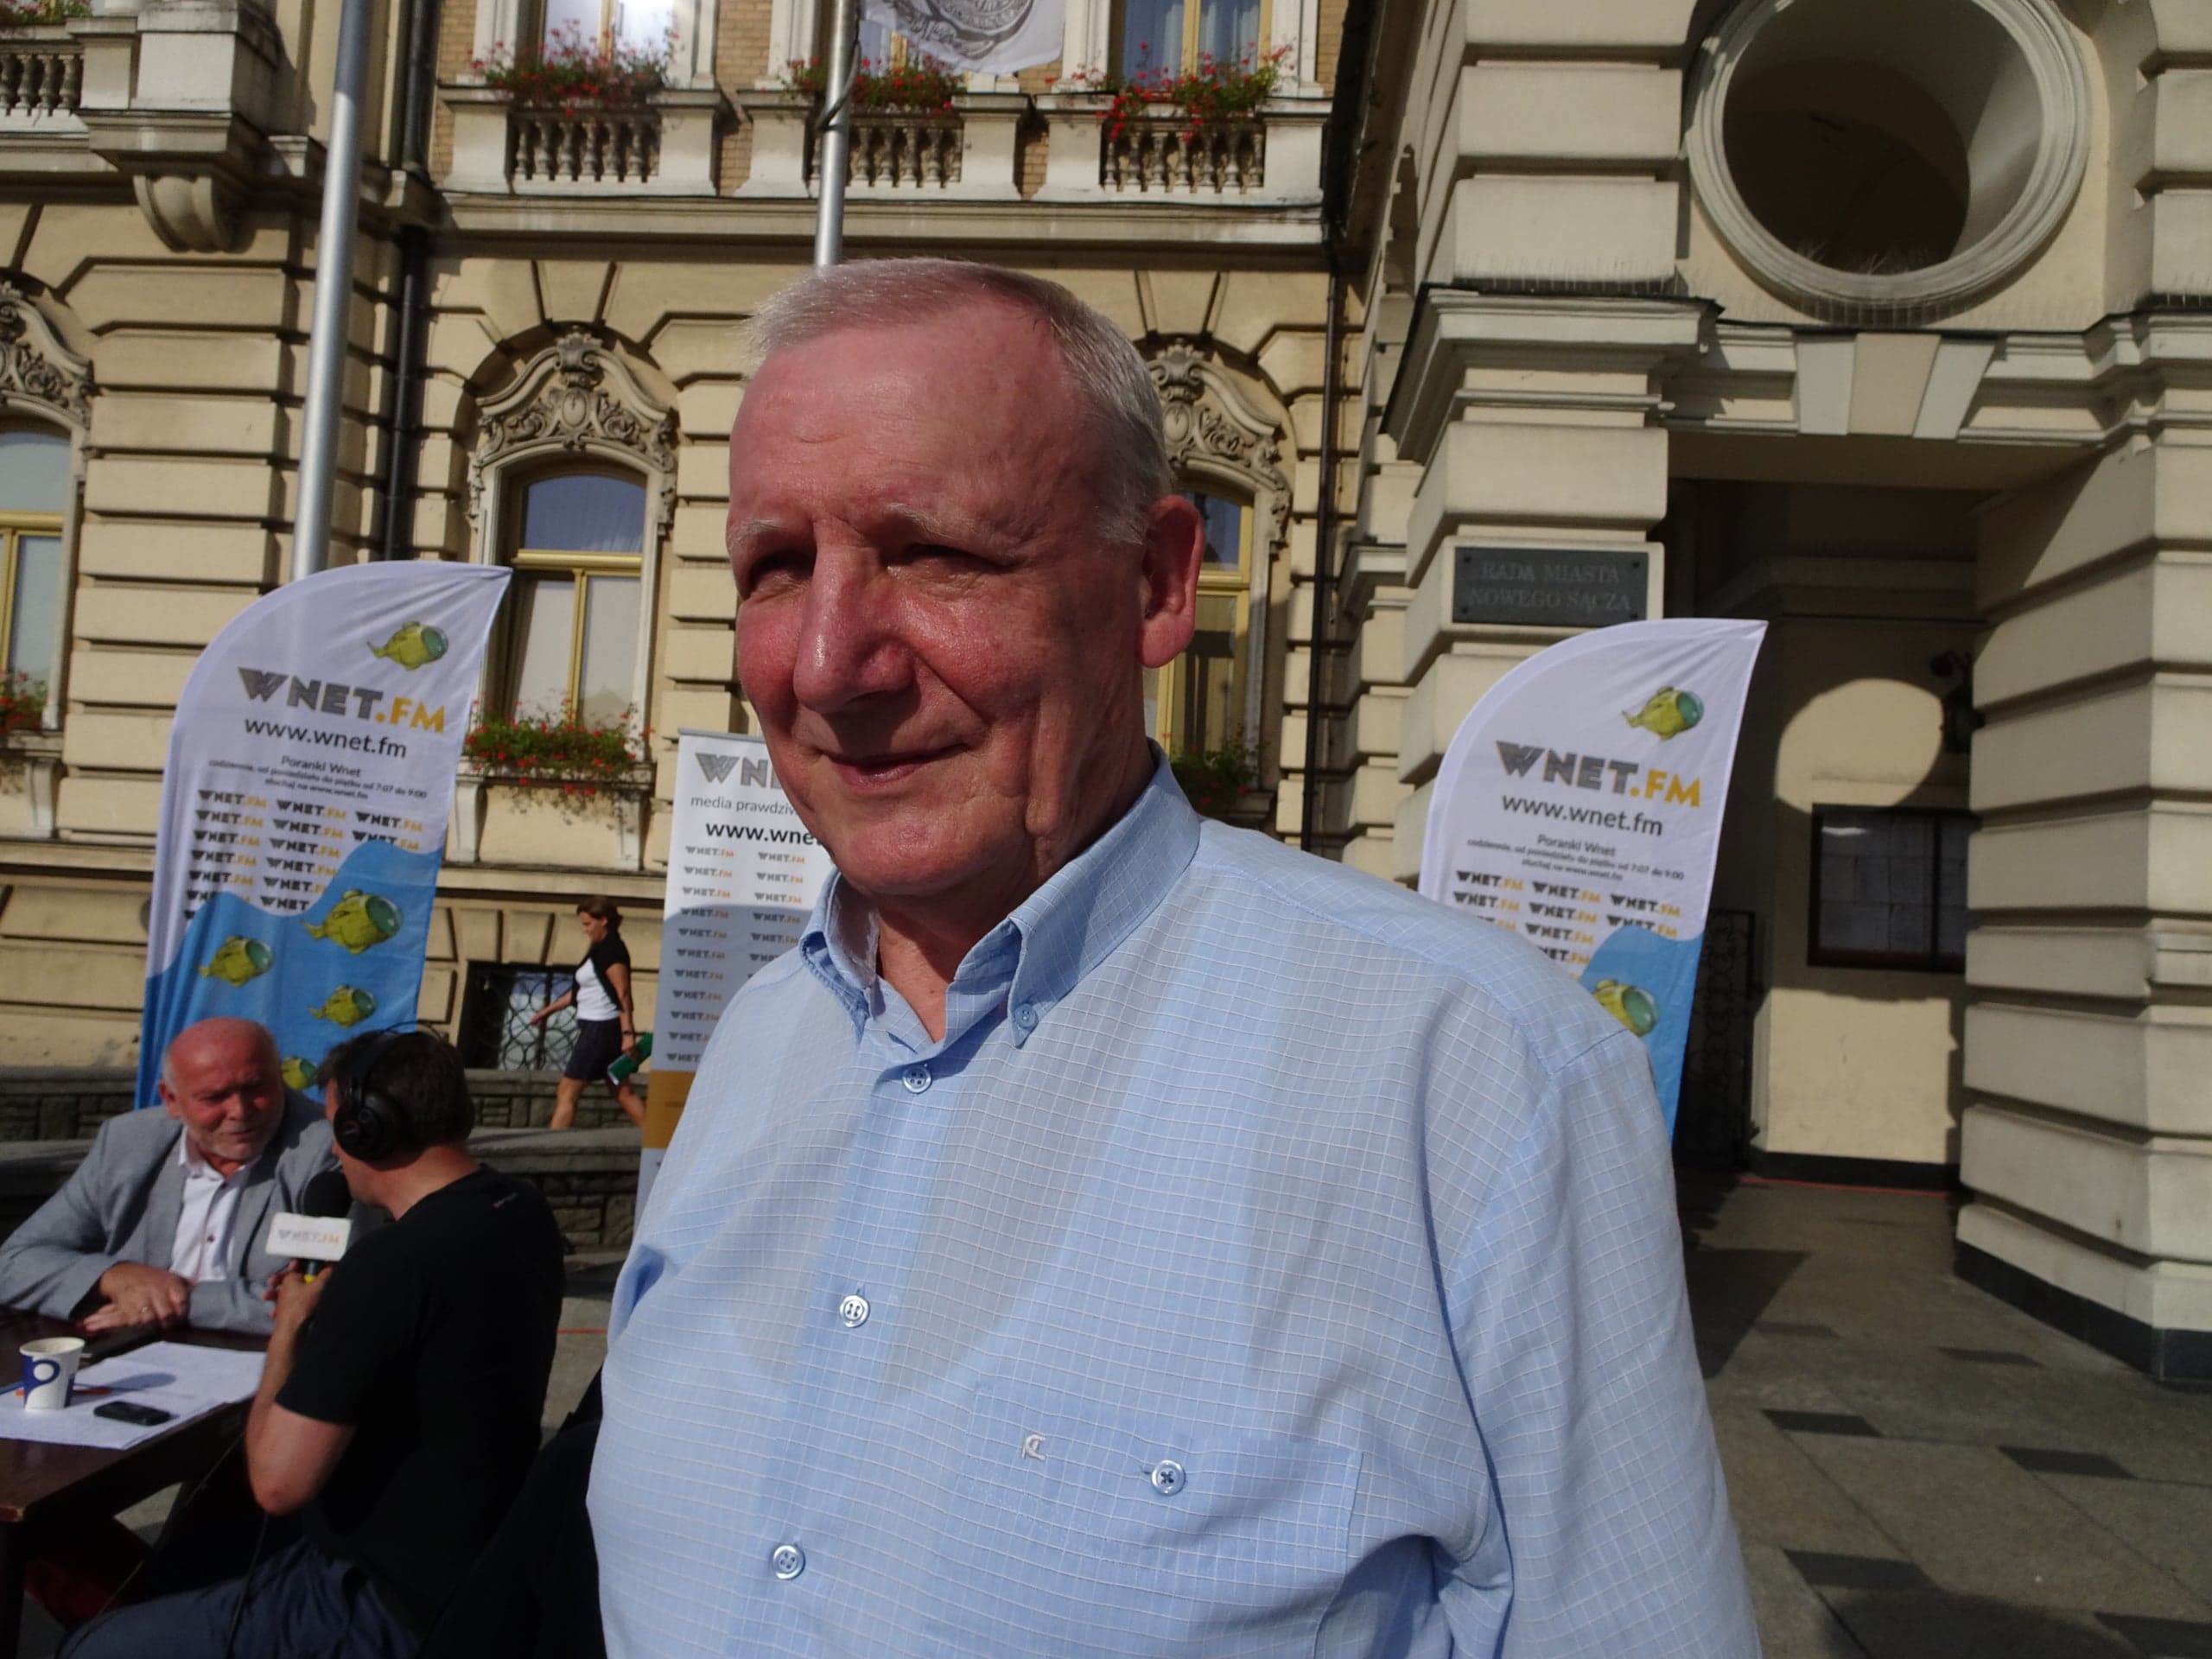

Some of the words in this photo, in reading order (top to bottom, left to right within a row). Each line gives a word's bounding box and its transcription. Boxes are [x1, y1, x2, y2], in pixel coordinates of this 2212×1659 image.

[1480, 563, 1535, 582] RADA
[1544, 563, 1620, 584] MIASTA
[1470, 587, 1561, 609] NOWEGO
[238, 665, 446, 734] WNET.FM
[244, 717, 407, 759] www.wnet.fm
[282, 755, 327, 772] Poranki
[329, 763, 361, 778] Wnet
[1495, 740, 1701, 808] WNET.FM
[198, 789, 268, 809] WNET.FM
[276, 799, 347, 820] WNET.FM
[355, 810, 423, 832] WNET.FM
[690, 795, 732, 810] media
[1502, 794, 1662, 836] www.wnet.fm
[195, 810, 264, 828] WNET.FM
[272, 818, 344, 839] WNET.FM
[705, 823, 823, 846] www.wne
[193, 830, 261, 848] WNET.FM
[269, 837, 340, 858] WNET.FM
[1537, 834, 1582, 851] Poranki
[1584, 842, 1616, 856] Wnet
[190, 849, 257, 868] WNET.FM
[188, 870, 254, 887] WNET.FM
[1455, 869, 1524, 891] WNET.FM
[1531, 880, 1601, 904] WNET.FM
[1610, 893, 1681, 918] WNET.FM
[1452, 890, 1520, 912] WNET.FM
[1529, 901, 1598, 925] WNET.FM
[1524, 922, 1594, 945] WNET.FM
